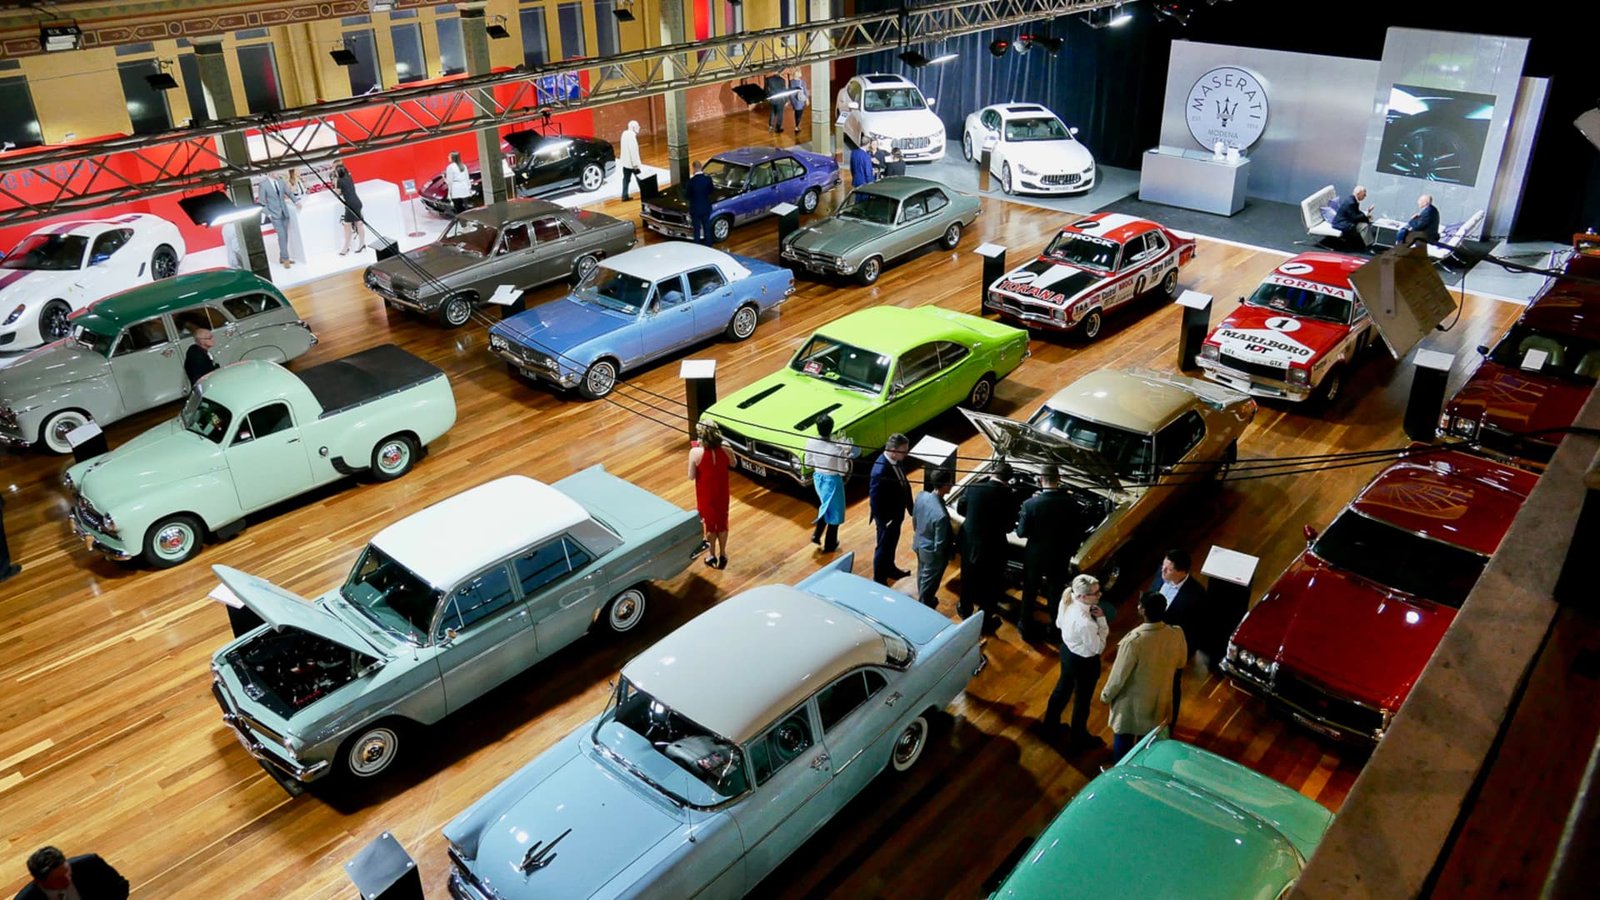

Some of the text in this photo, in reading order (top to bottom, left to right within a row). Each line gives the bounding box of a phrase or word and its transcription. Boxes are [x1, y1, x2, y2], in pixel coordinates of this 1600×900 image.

[1192, 74, 1262, 119] MASERATI
[1208, 128, 1239, 139] MODENA
[1061, 231, 1113, 248] BROCK
[998, 280, 1066, 305] TORANA
[1273, 276, 1346, 298] TORANA
[1274, 319, 1290, 329] 1
[1221, 330, 1311, 357] MARLBORO
[1268, 359, 1283, 367] GTX
